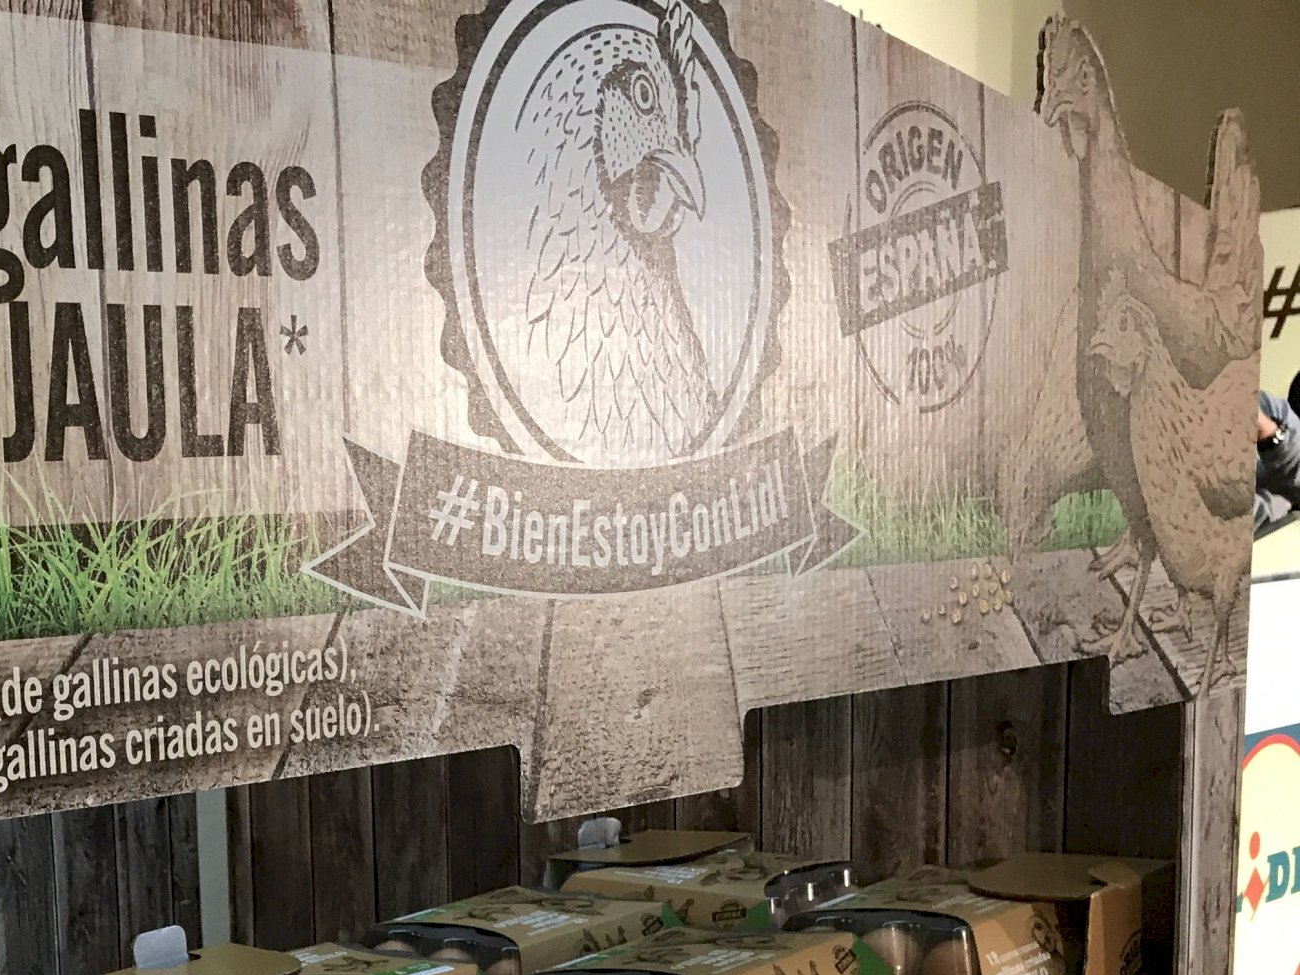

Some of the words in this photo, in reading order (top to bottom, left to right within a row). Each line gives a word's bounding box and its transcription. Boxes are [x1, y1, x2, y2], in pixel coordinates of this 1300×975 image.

[865, 126, 963, 213] ORIGEN
[429, 458, 789, 577] #BienEstoyConLidl
[53, 658, 178, 722] gallinas
[186, 637, 357, 697] ecológicas),
[125, 711, 239, 761] criadas
[247, 711, 283, 748] en
[290, 690, 380, 744] suelo).
